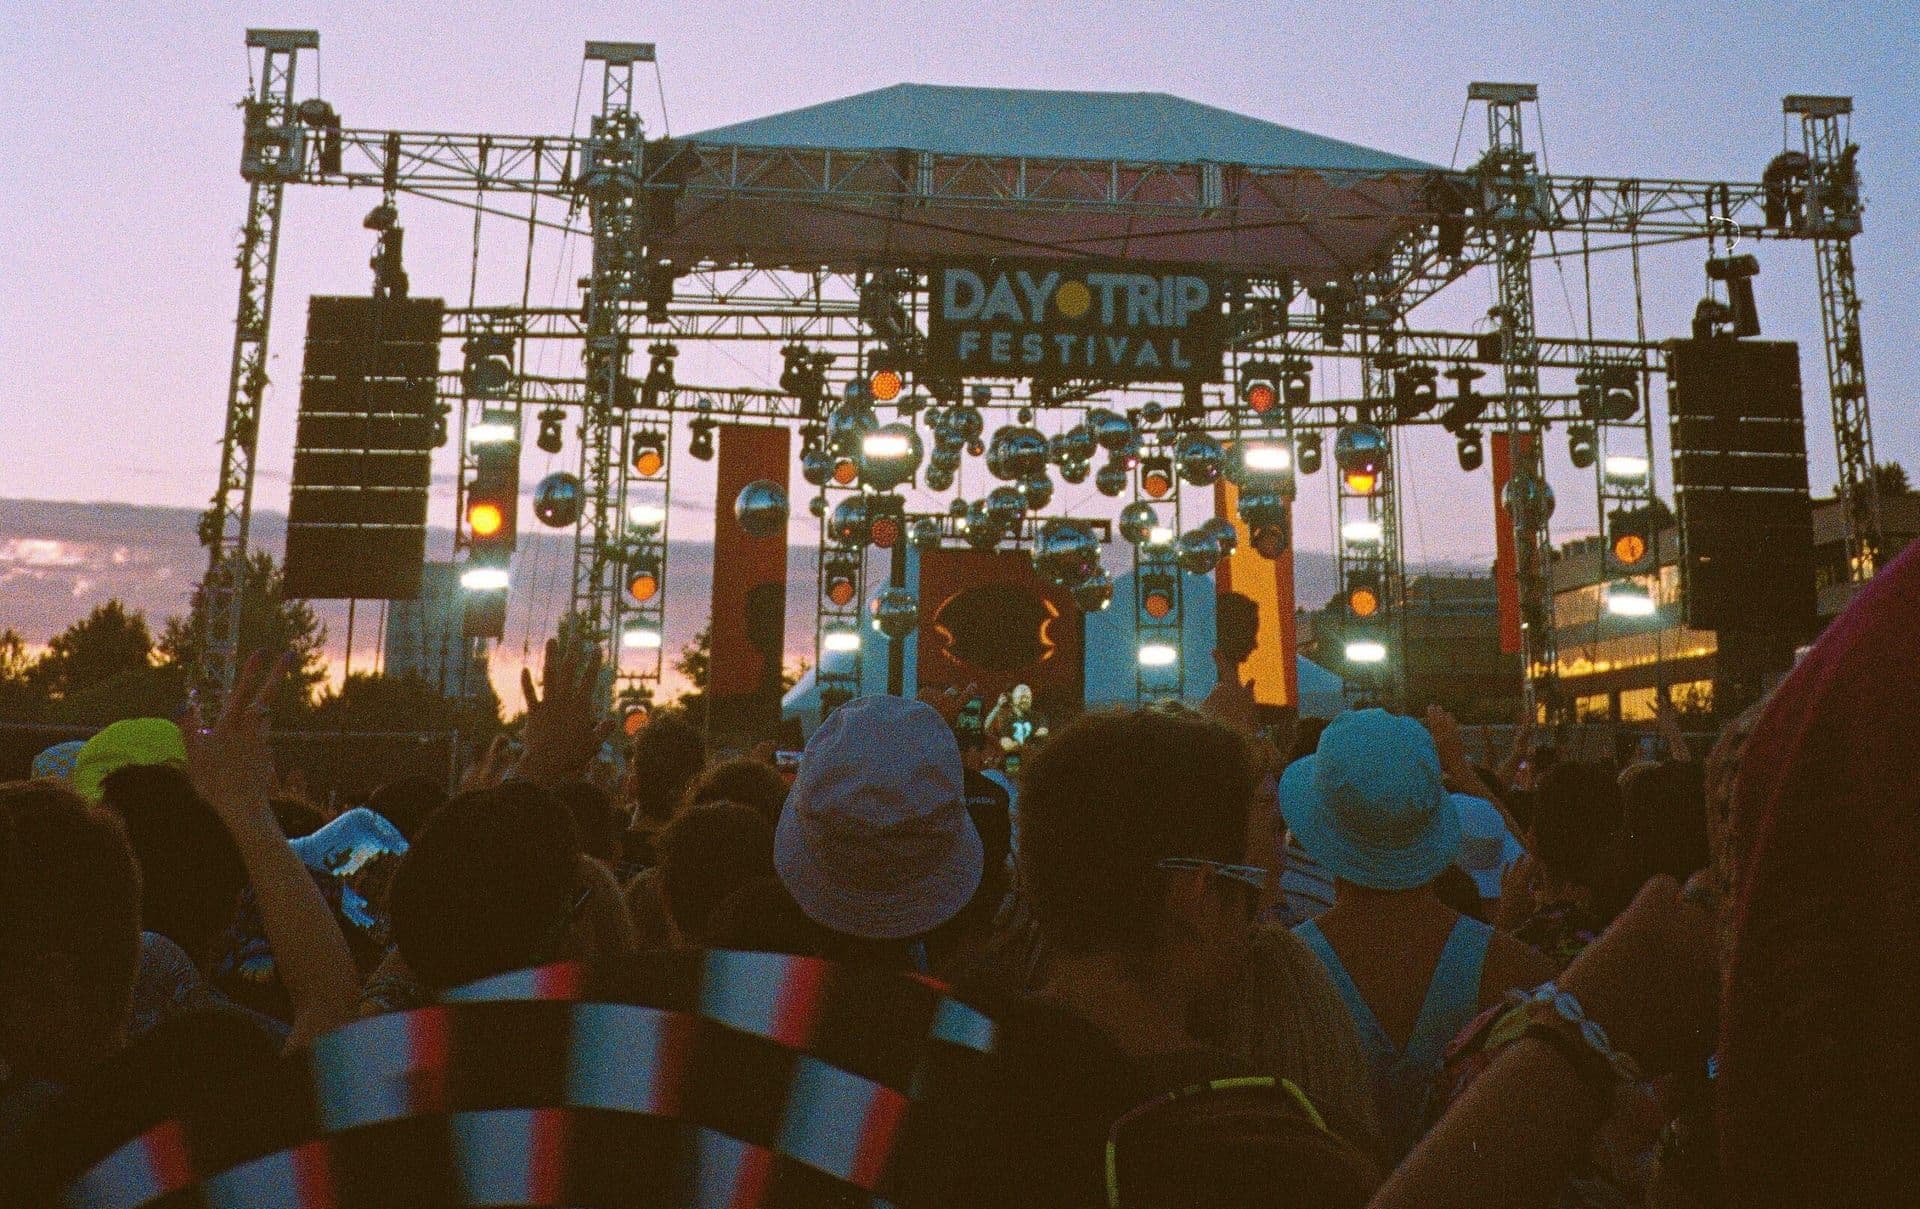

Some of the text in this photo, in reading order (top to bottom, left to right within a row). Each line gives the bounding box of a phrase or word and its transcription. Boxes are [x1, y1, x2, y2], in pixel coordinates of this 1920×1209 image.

[943, 268, 1210, 327] DAY TRIP
[958, 330, 1191, 370] FESTIVAL
